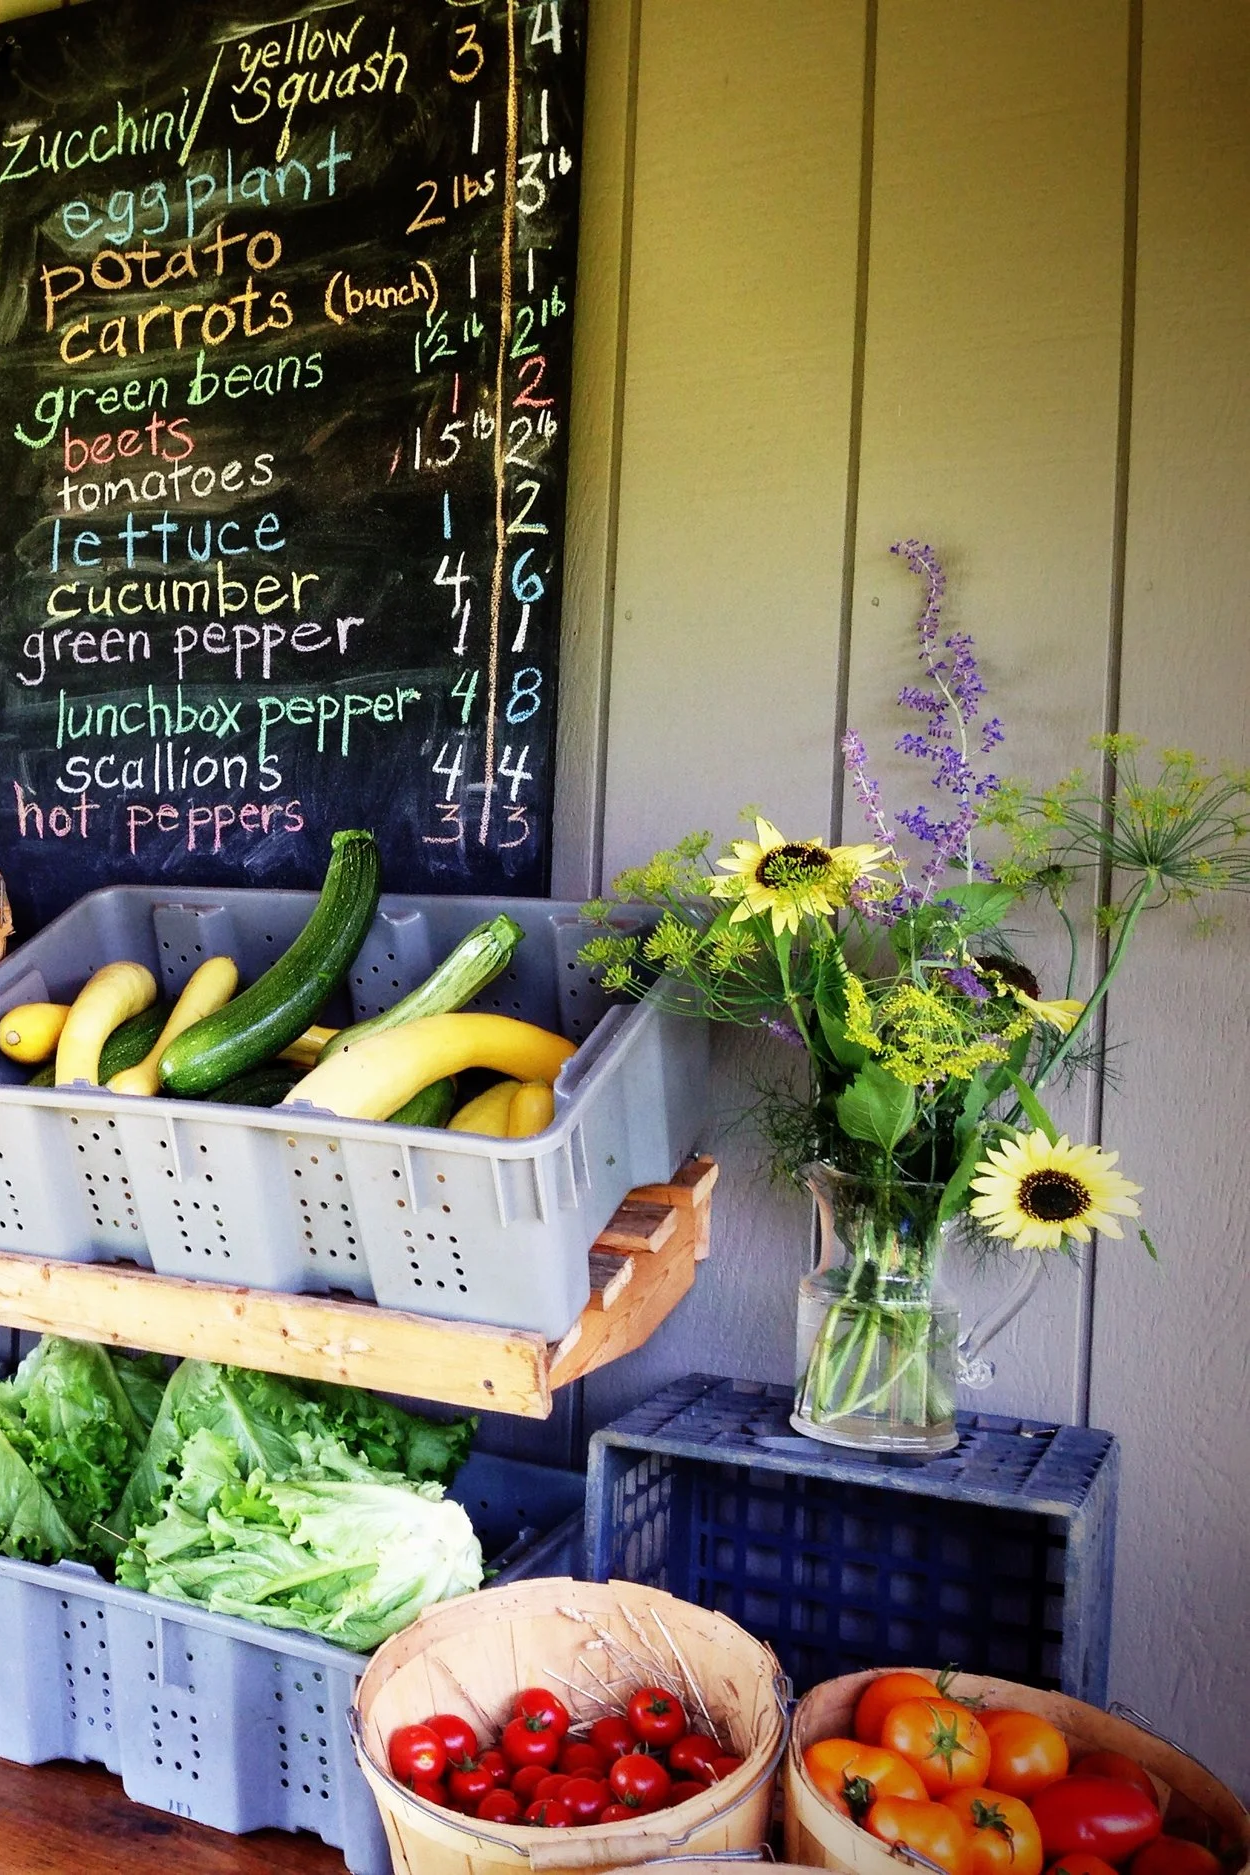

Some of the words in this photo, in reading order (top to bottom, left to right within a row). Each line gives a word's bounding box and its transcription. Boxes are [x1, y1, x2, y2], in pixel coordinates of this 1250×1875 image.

[231, 15, 365, 96] yellow
[450, 24, 485, 84] 3
[530, 0, 564, 54] 4
[231, 26, 409, 163] squash
[471, 99, 481, 155] 1
[540, 88, 549, 146] 1
[40, 223, 283, 333] potato
[405, 179, 447, 236] 2
[515, 151, 547, 216] 3
[59, 276, 295, 366] carrots
[324, 260, 439, 328] (bunch)
[13, 377, 169, 450] green
[187, 350, 325, 407] beans
[508, 305, 540, 360] 2
[63, 411, 197, 473] beets
[511, 355, 555, 409] 2
[57, 452, 276, 513] tomatoes
[504, 415, 537, 469] 2
[50, 509, 287, 574] lettuce
[506, 479, 549, 535] 2
[46, 559, 321, 619] cucumber
[432, 551, 471, 619] 4
[511, 548, 545, 604] 6
[16, 626, 152, 687] green
[173, 615, 366, 681] pepper
[54, 684, 243, 750] lunchbox
[257, 686, 422, 758] pepper
[451, 668, 480, 725] 4
[504, 666, 543, 724] 8
[13, 781, 101, 840] hot
[125, 797, 306, 855] peppers
[421, 803, 464, 844] 3
[498, 804, 531, 849] 3
[55, 740, 284, 796] scallions
[432, 742, 464, 802] 4
[497, 744, 534, 803] 4
